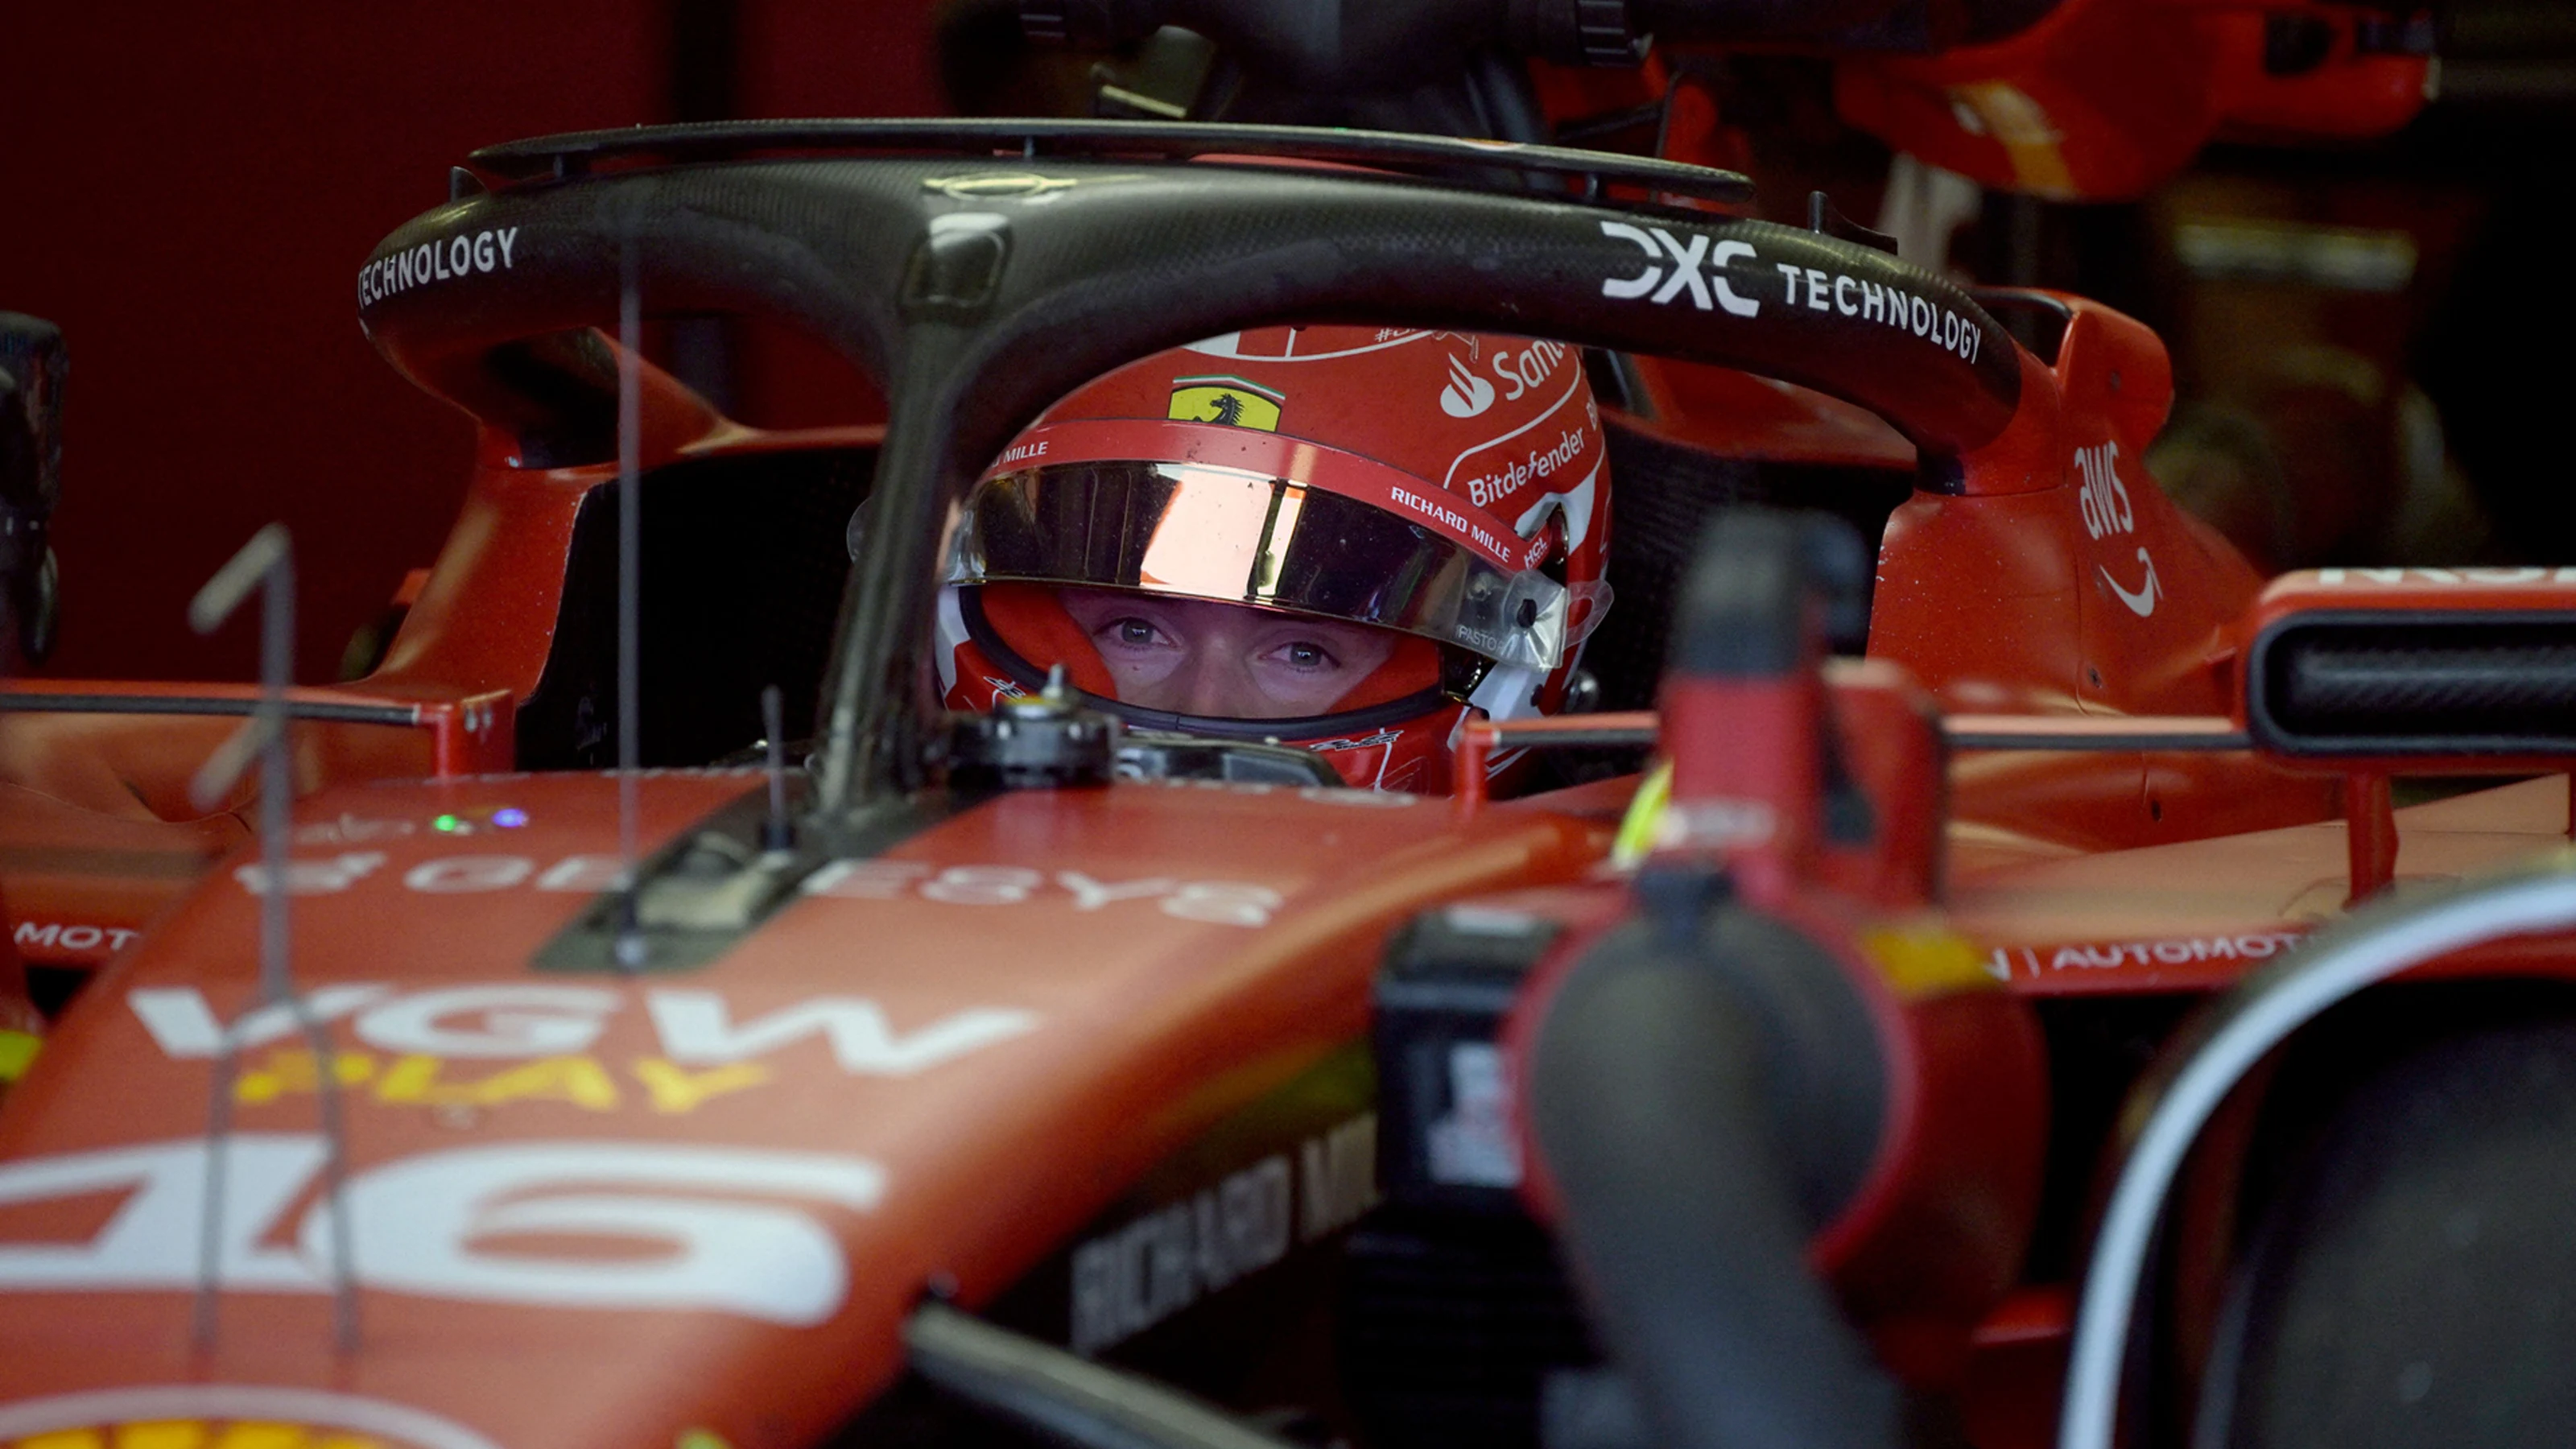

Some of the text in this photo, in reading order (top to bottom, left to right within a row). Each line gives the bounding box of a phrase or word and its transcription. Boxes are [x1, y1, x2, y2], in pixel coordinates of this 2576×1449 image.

[1599, 221, 1982, 365] DXC TECHNOLOGY
[1003, 441, 1049, 463] MILLE
[1467, 427, 1584, 507] Bitdefender
[2074, 440, 2133, 540] aws
[1391, 486, 1511, 563] RICHARD MILLE
[2054, 933, 2307, 972] AUTOMOT
[126, 982, 1045, 1075] VGW
[234, 1055, 771, 1114] PLAY
[0, 1132, 886, 1327] 16
